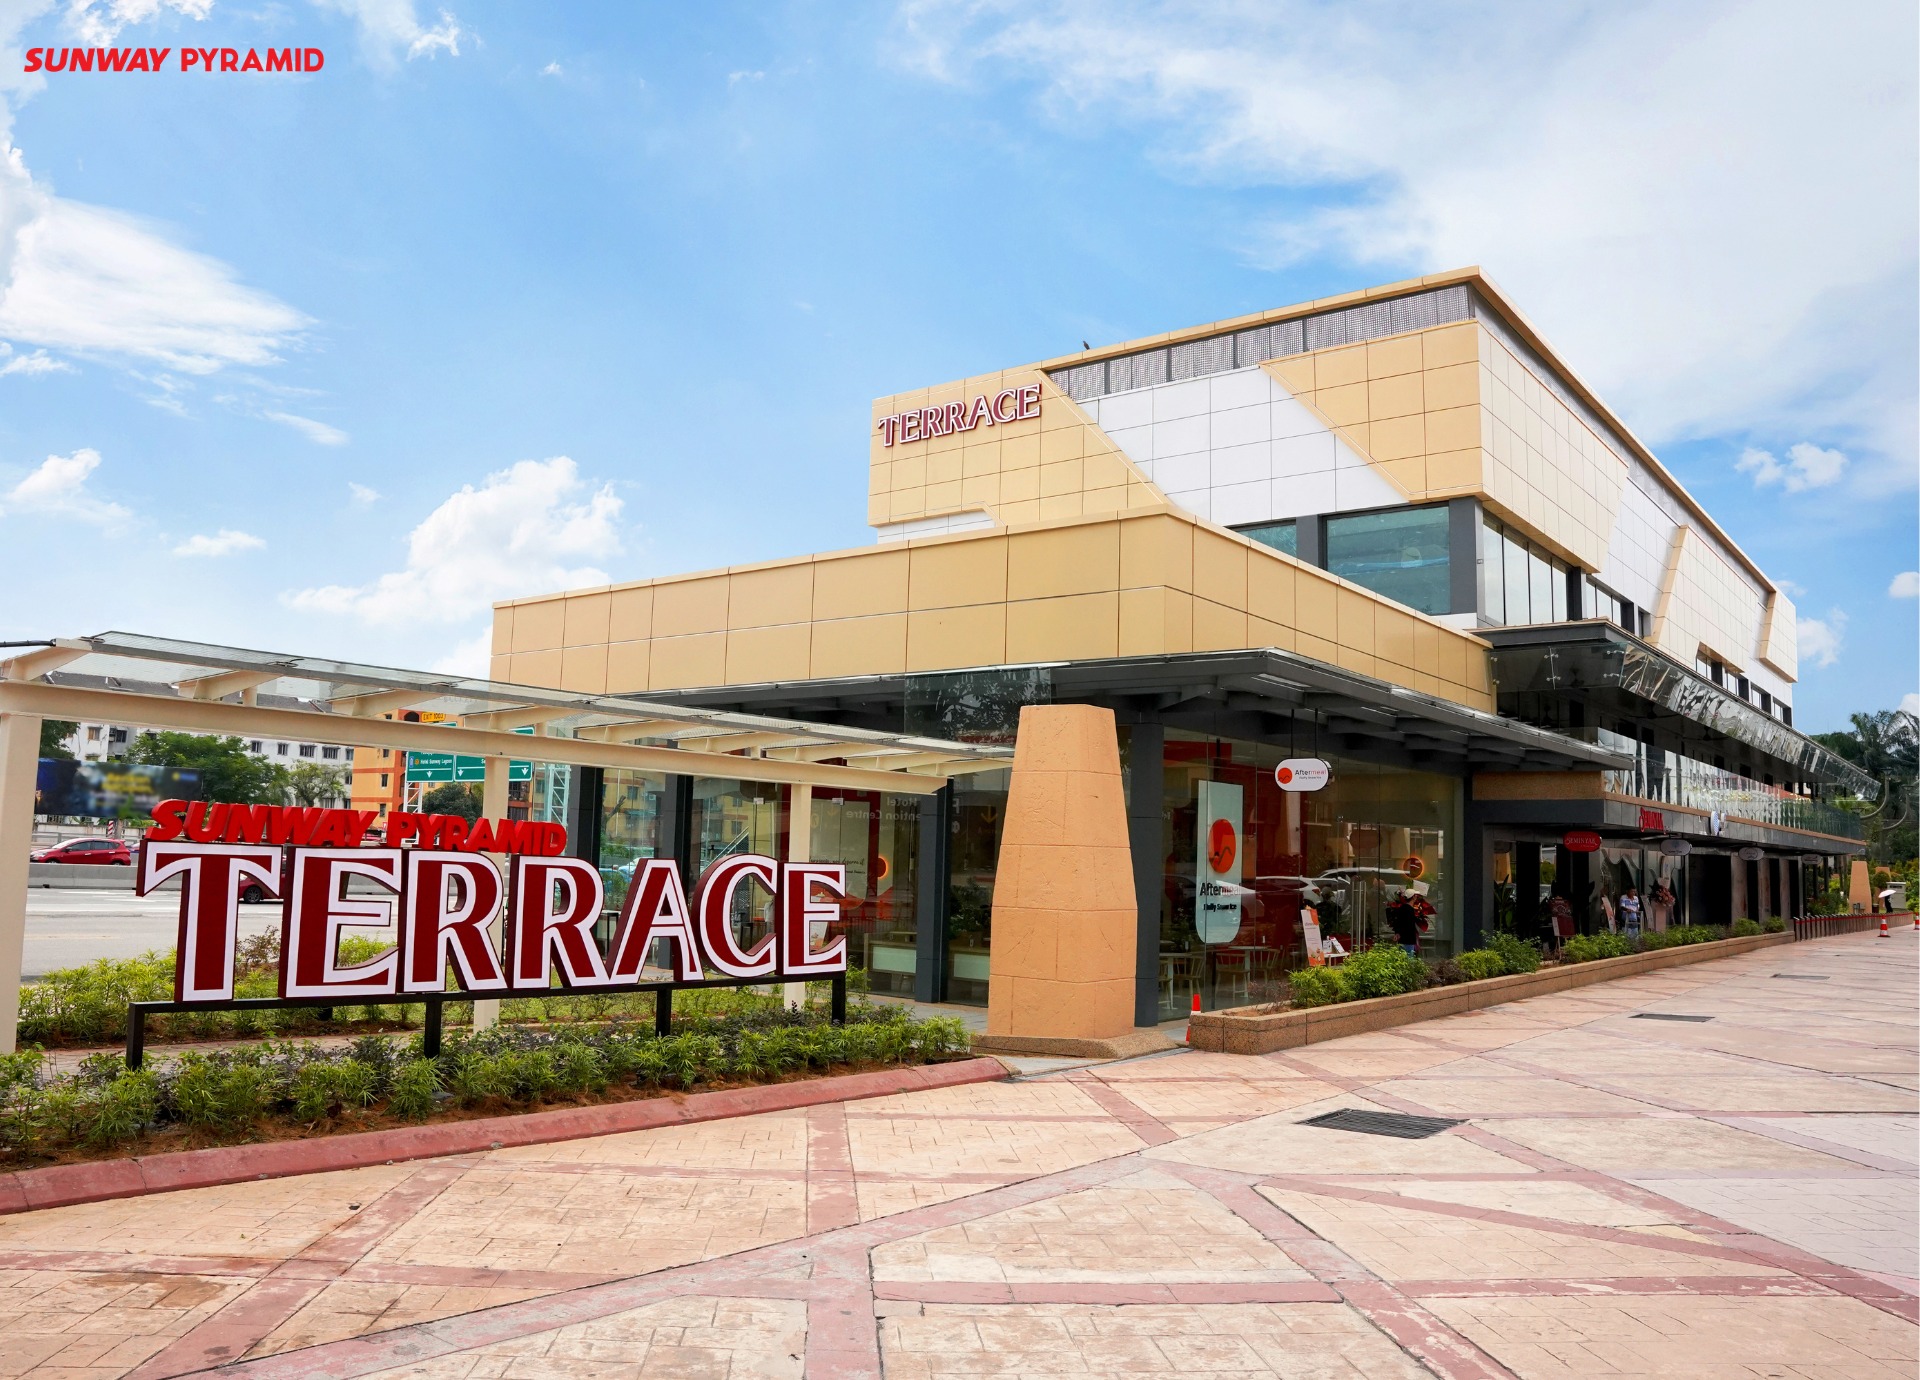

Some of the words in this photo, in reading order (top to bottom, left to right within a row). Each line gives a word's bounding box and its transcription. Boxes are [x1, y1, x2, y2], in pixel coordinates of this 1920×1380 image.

[877, 383, 1043, 447] TERRACE
[145, 799, 379, 848] SUNWAY
[386, 811, 567, 857] PYRAMID
[136, 838, 847, 1001] TERRACE
